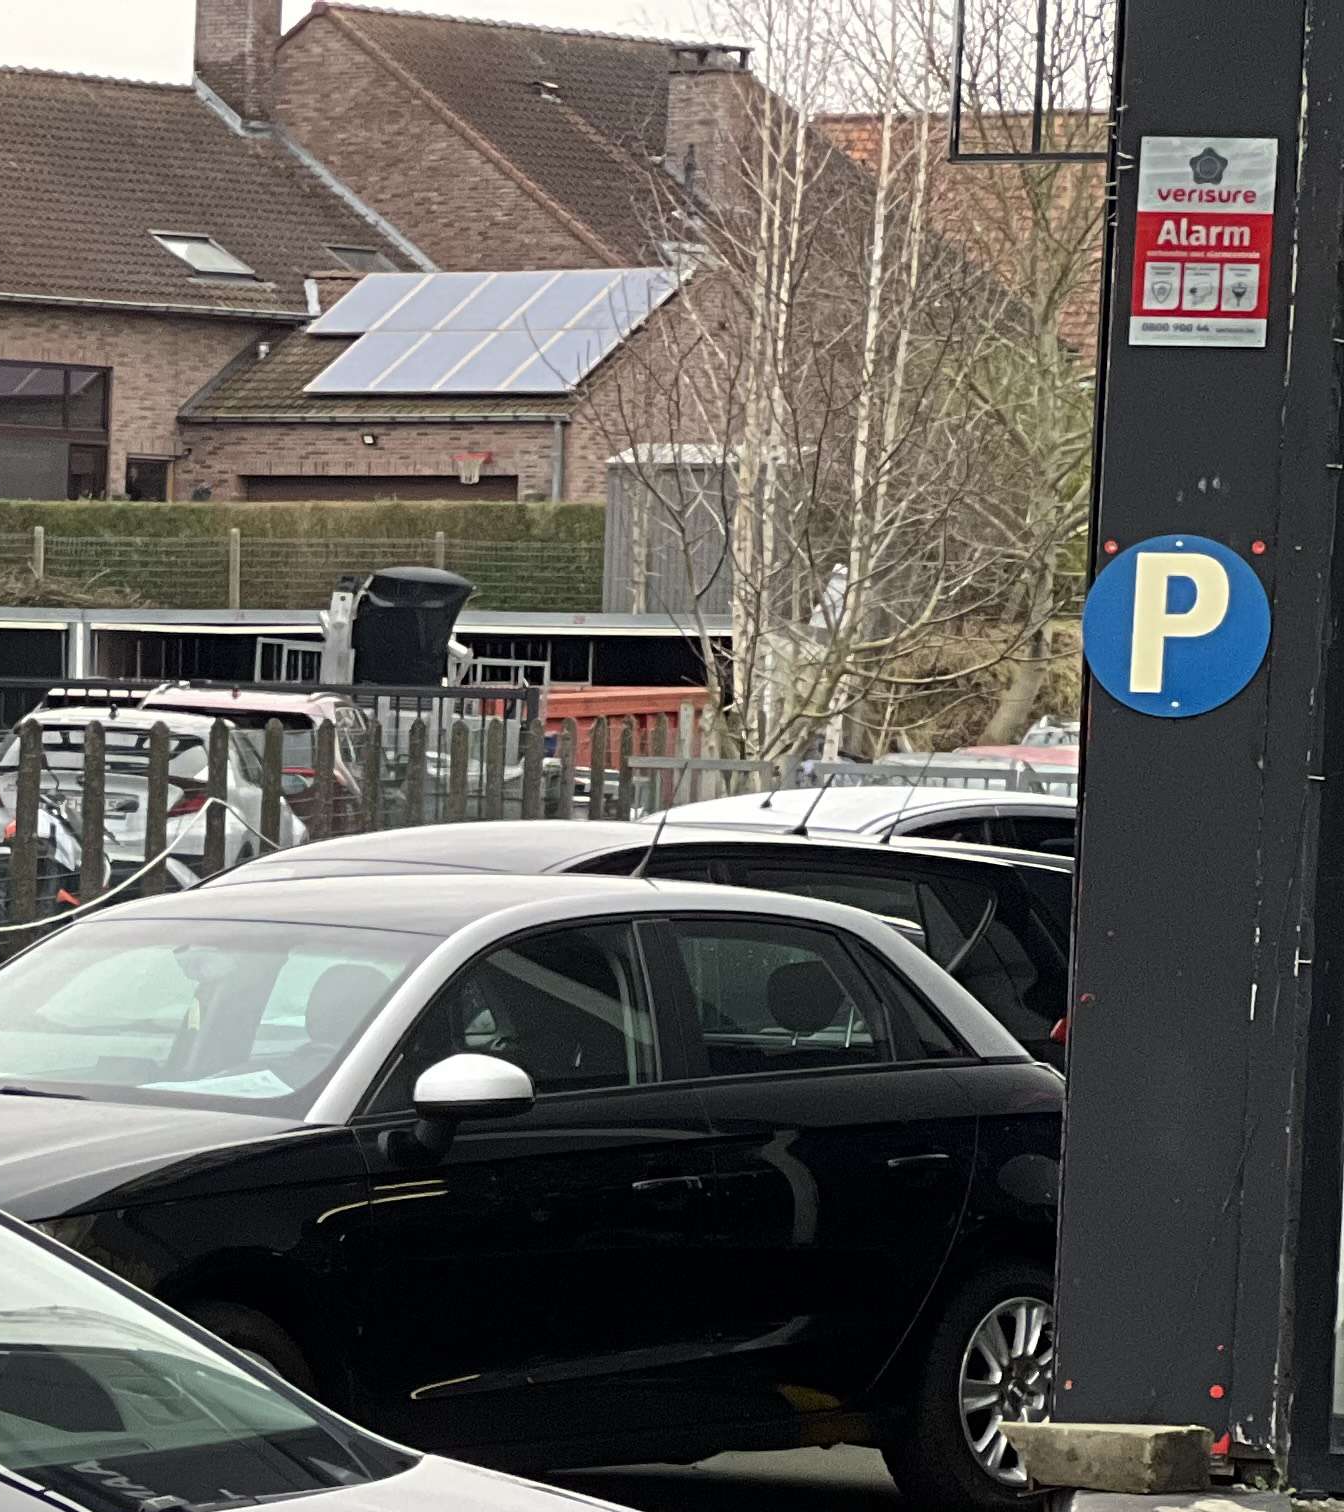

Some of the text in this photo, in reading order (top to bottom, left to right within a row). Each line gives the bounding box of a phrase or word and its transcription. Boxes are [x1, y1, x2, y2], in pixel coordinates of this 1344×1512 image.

[1157, 186, 1257, 204] verisure
[1156, 217, 1251, 247] Alarm
[1129, 552, 1230, 693] P
